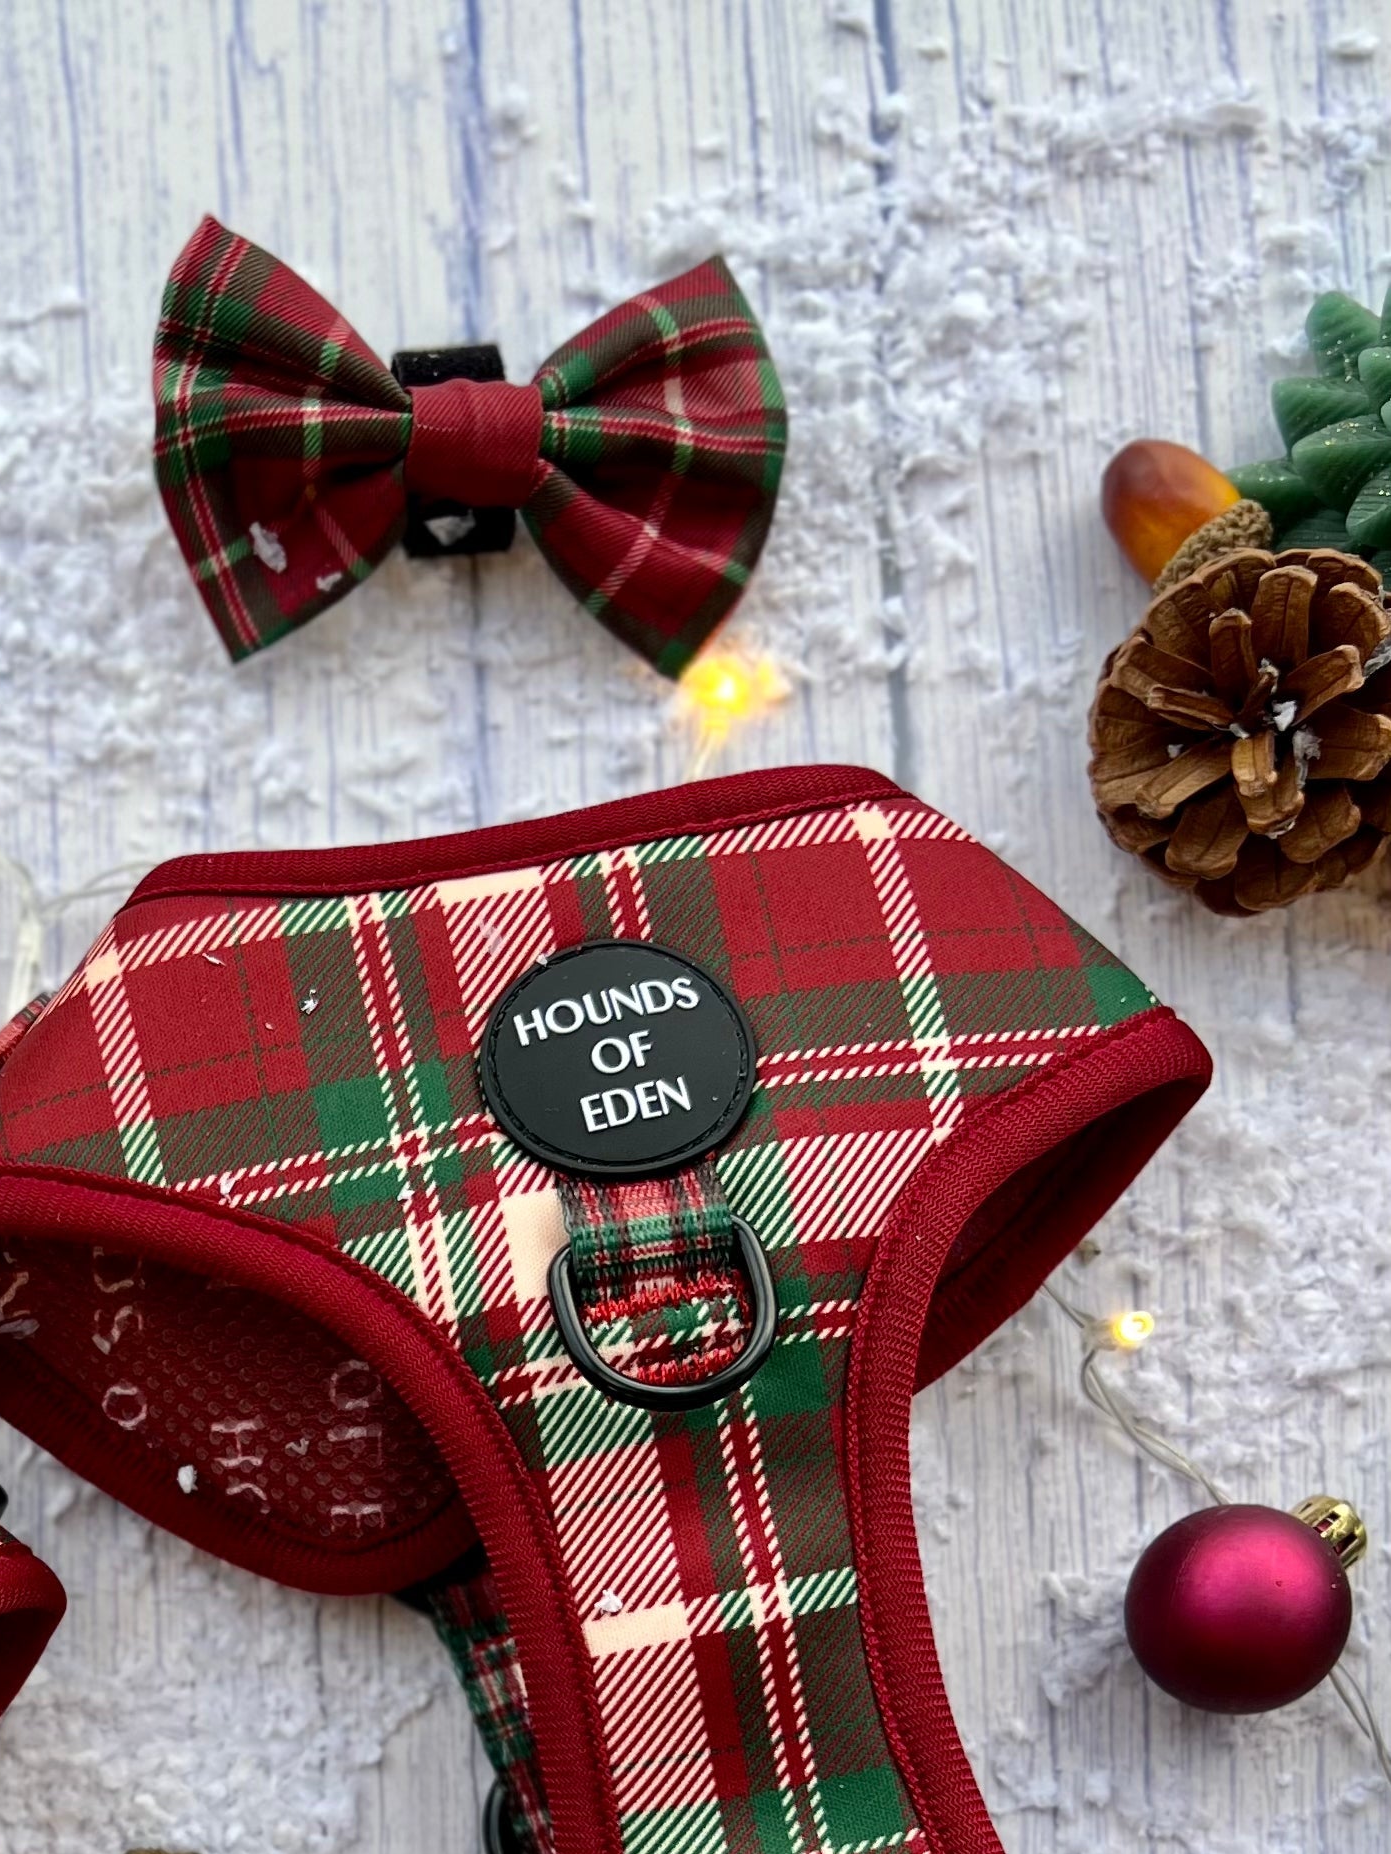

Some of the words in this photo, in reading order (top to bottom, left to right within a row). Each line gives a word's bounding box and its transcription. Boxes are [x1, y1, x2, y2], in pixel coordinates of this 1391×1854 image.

[513, 976, 699, 1046] HOUNDS
[591, 1030, 652, 1074] OF
[580, 1076, 692, 1133] EDEN
